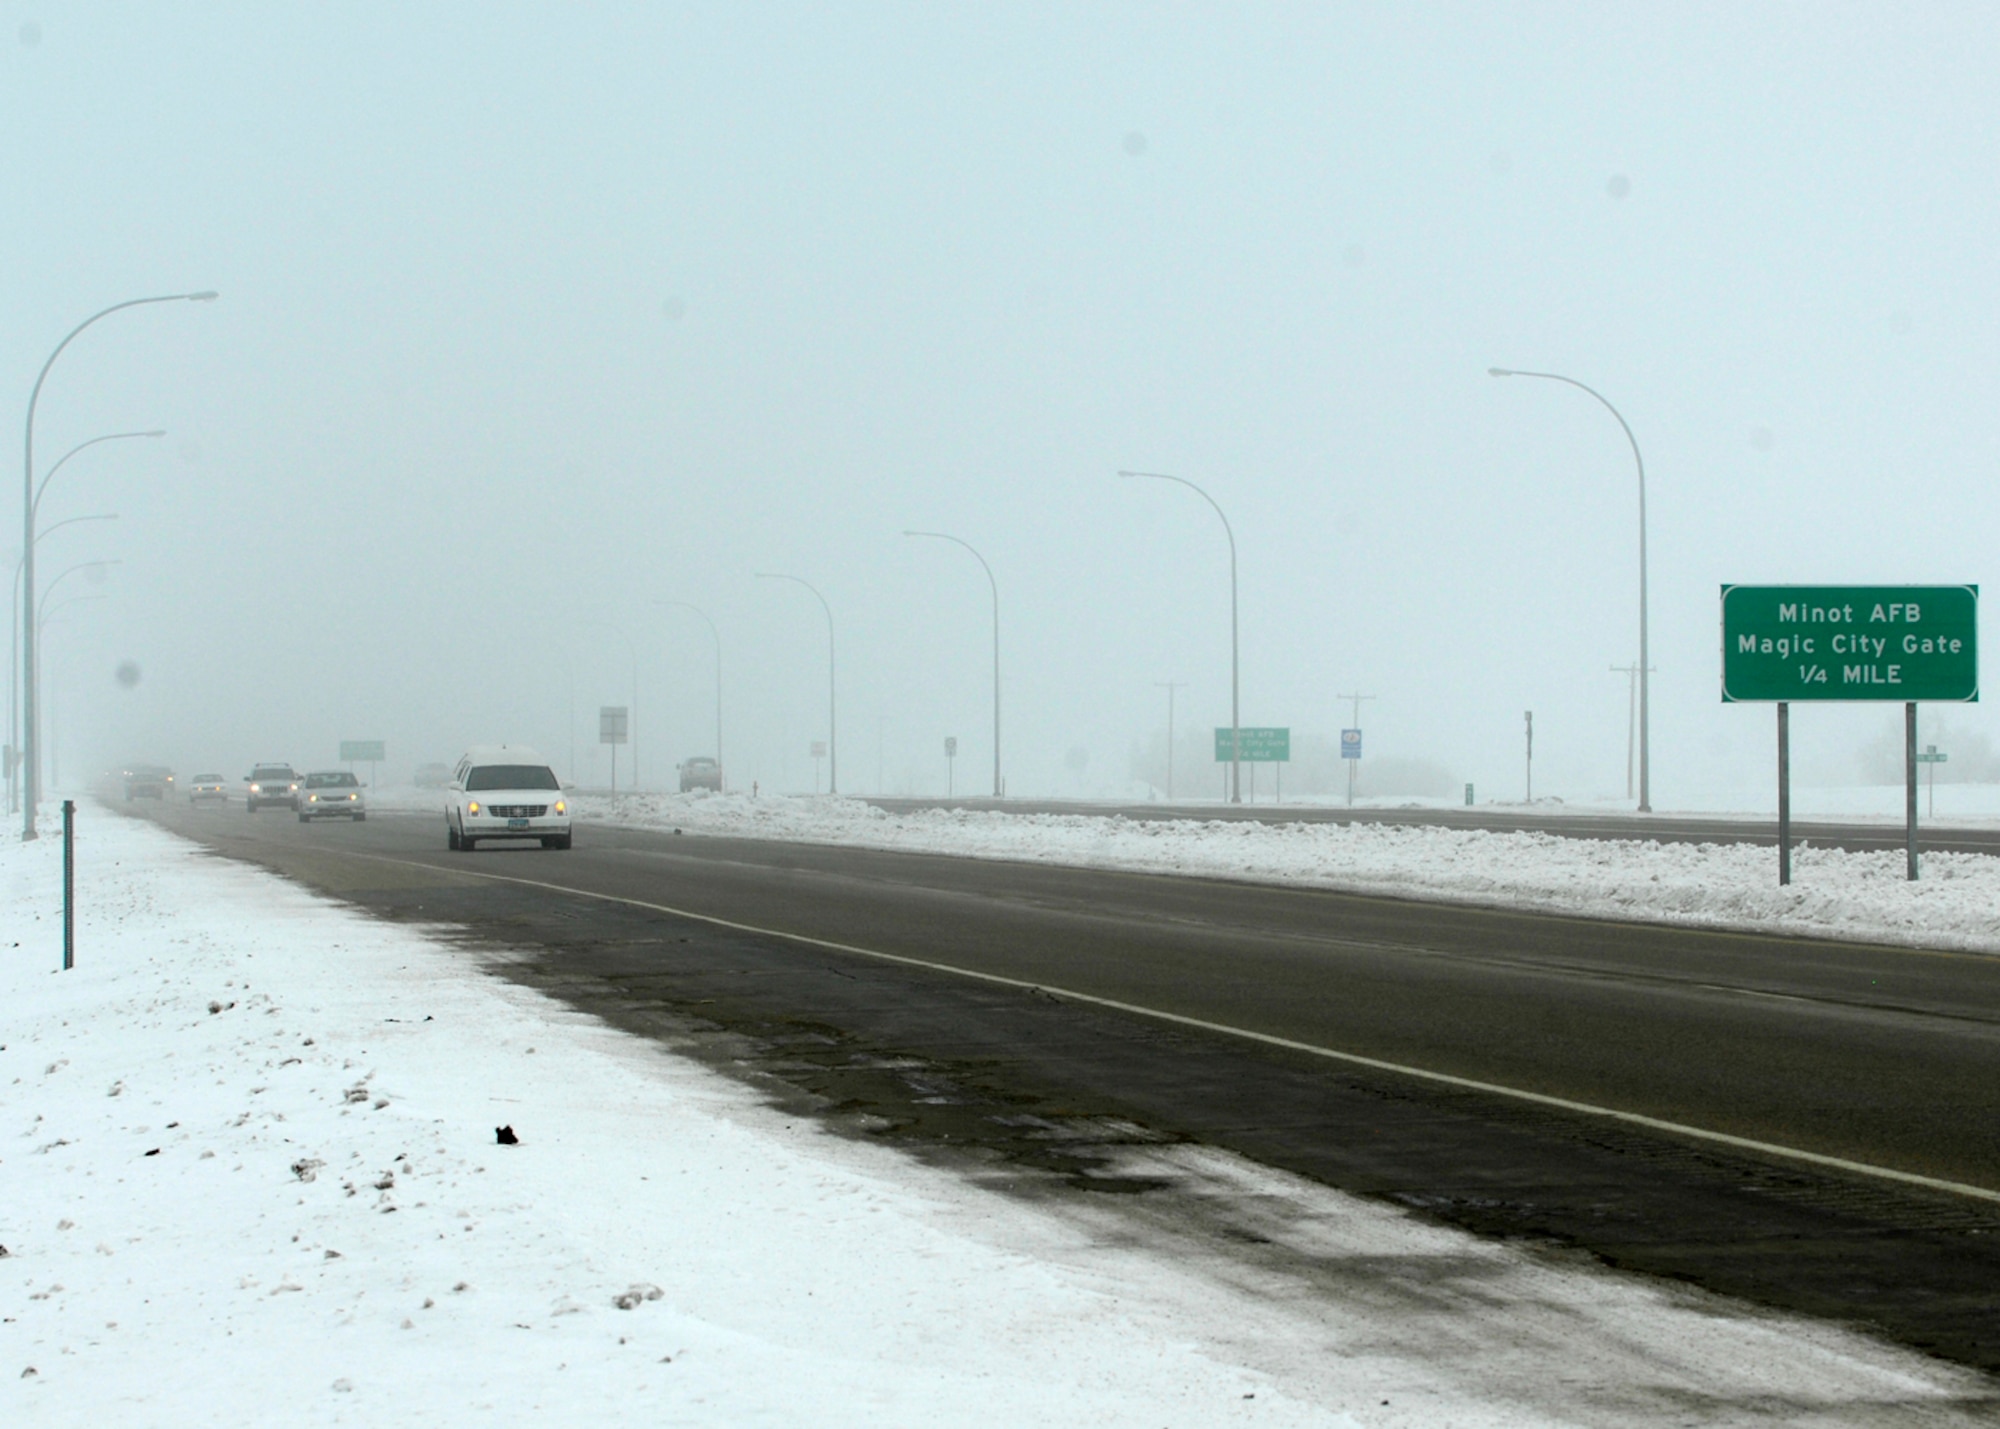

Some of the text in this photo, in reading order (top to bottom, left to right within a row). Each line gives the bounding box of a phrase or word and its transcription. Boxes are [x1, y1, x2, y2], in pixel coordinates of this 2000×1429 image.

[1779, 603, 1921, 622] Minot AFB
[1738, 634, 1963, 659] Magic City Gate
[1799, 664, 1902, 684] 1/4 MILE
